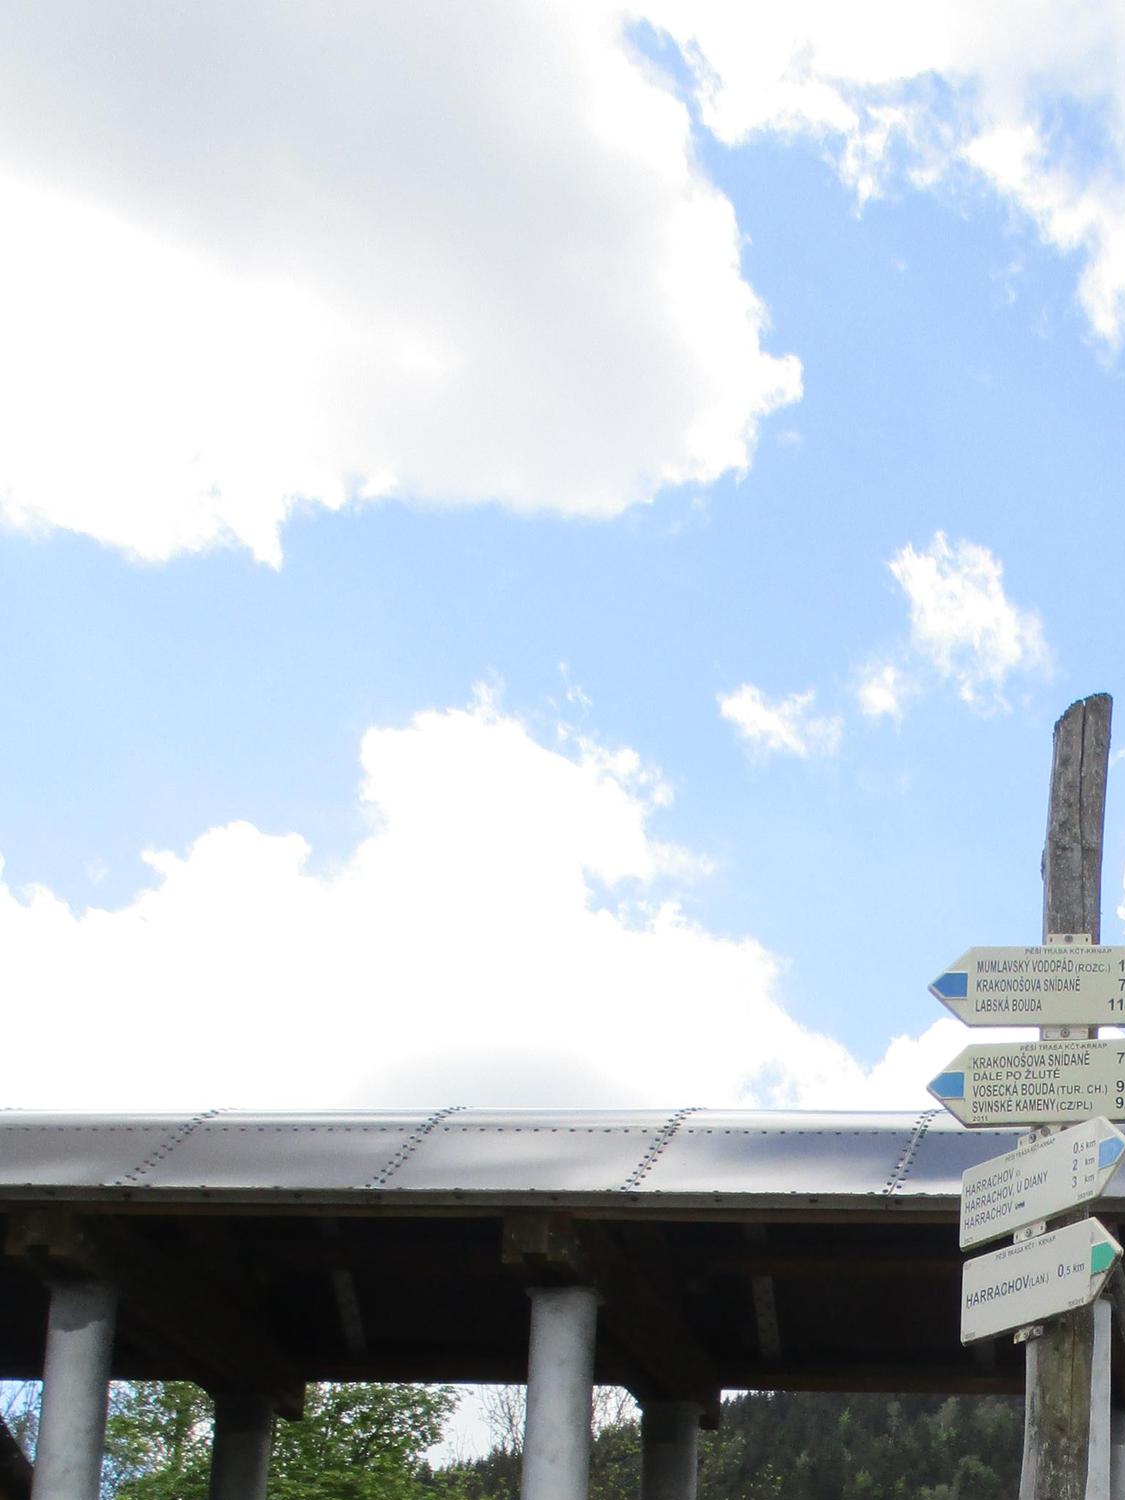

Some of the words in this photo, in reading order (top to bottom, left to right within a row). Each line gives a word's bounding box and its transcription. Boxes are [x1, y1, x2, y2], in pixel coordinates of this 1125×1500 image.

[977, 956, 1030, 973] MUMLAVSKÝ
[1032, 957, 1073, 973] VODOPÁD
[1118, 960, 1124, 972] 1
[976, 976, 1041, 992] KRAKONOŠOVA
[975, 996, 1009, 1012] LABSKÁ
[1012, 999, 1042, 1012] BOUDA
[972, 1052, 1046, 1069] KRAKONOŠOVA
[1048, 1050, 1090, 1067] SNÍDANĚ
[1117, 1052, 1125, 1064] 7
[973, 1070, 1002, 1081] DÁLE
[1006, 1071, 1022, 1080] PO
[1025, 1067, 1061, 1080] ŽLUTÉ
[973, 1081, 1018, 1097] VOSECKÁ
[1021, 1082, 1055, 1096] BOUDA
[1087, 1084, 1108, 1095] CH.)
[1116, 1080, 1125, 1093] 9
[1015, 1098, 1056, 1112] KAMENY
[1057, 1101, 1093, 1112] (CZ/PL)
[965, 1168, 1014, 1197] HARRACHOV
[1073, 1142, 1084, 1154] 0,5
[1086, 1140, 1096, 1149] km
[1016, 1181, 1022, 1193] U
[1024, 1170, 1048, 1191] DIANY
[1072, 1159, 1078, 1171] 2
[1085, 1157, 1095, 1166] km
[964, 1201, 1013, 1230] HARRACHOV
[1072, 1176, 1077, 1188] 3
[1084, 1174, 1094, 1182] km
[1057, 1264, 1071, 1278] 0,5
[1072, 1263, 1085, 1273] km
